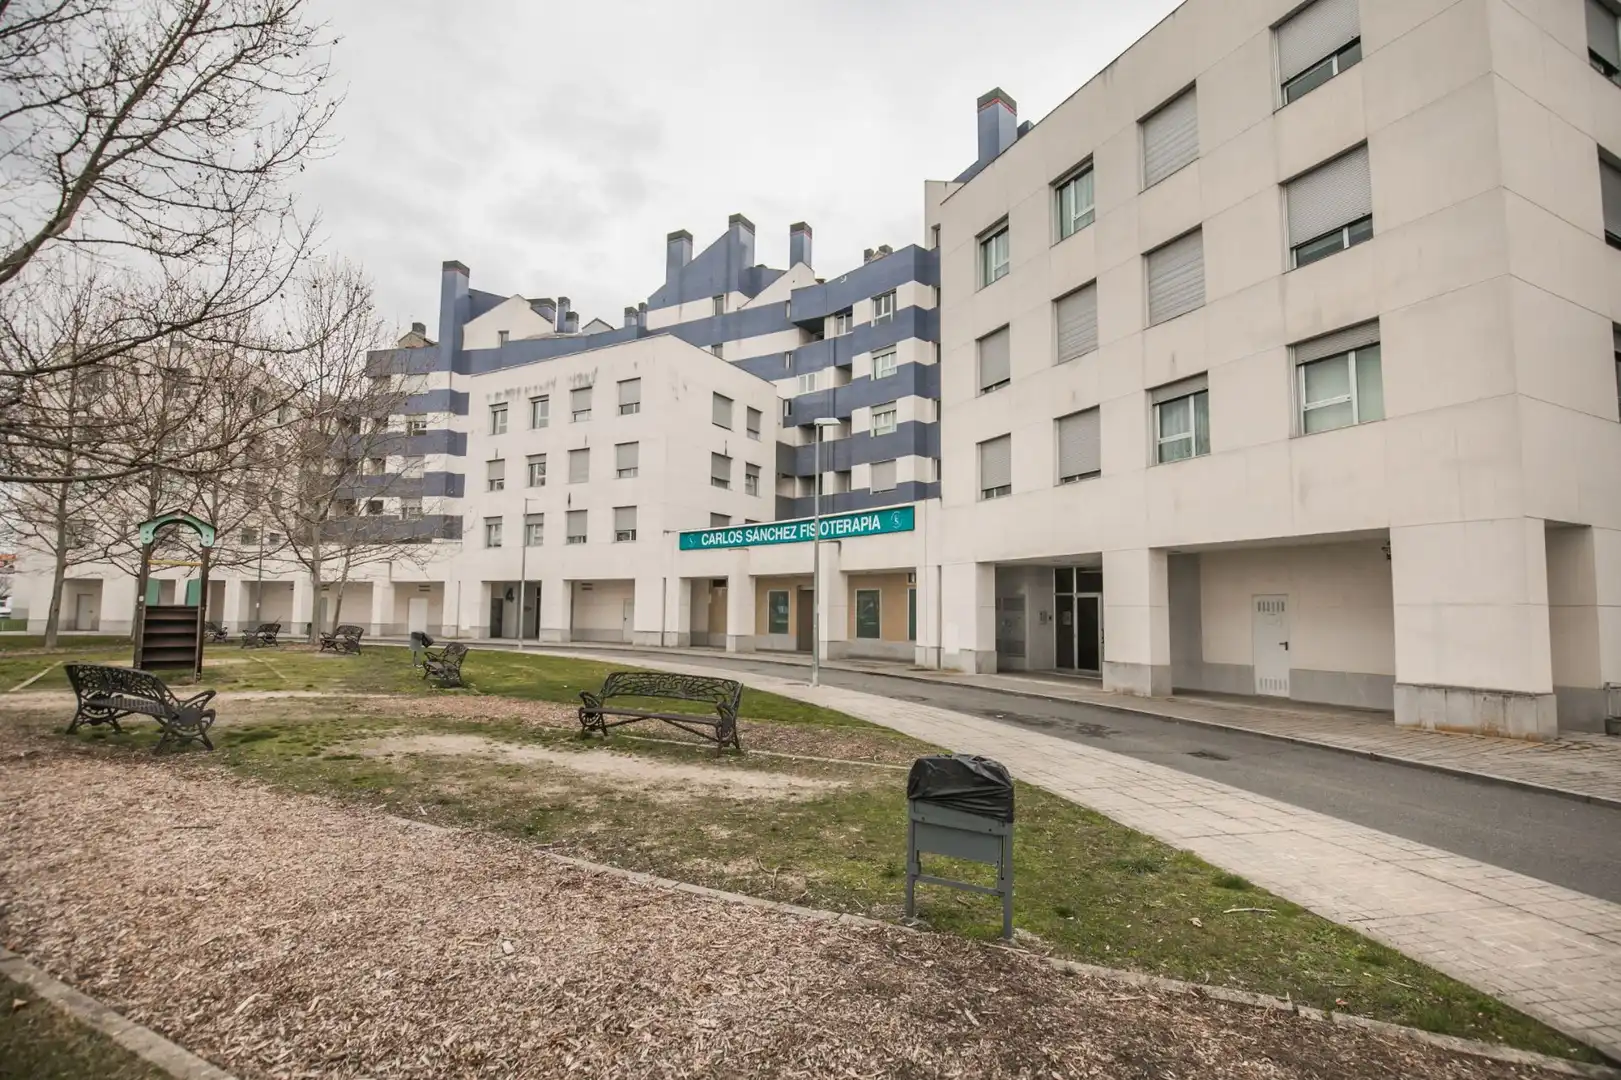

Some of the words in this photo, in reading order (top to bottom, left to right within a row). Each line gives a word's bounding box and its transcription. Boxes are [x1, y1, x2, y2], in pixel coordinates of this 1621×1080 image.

[701, 530, 743, 546] CARLOS
[745, 525, 797, 542] SÁNCHEZ
[800, 514, 881, 538] FISOTERAPIA
[505, 587, 515, 603] 4
